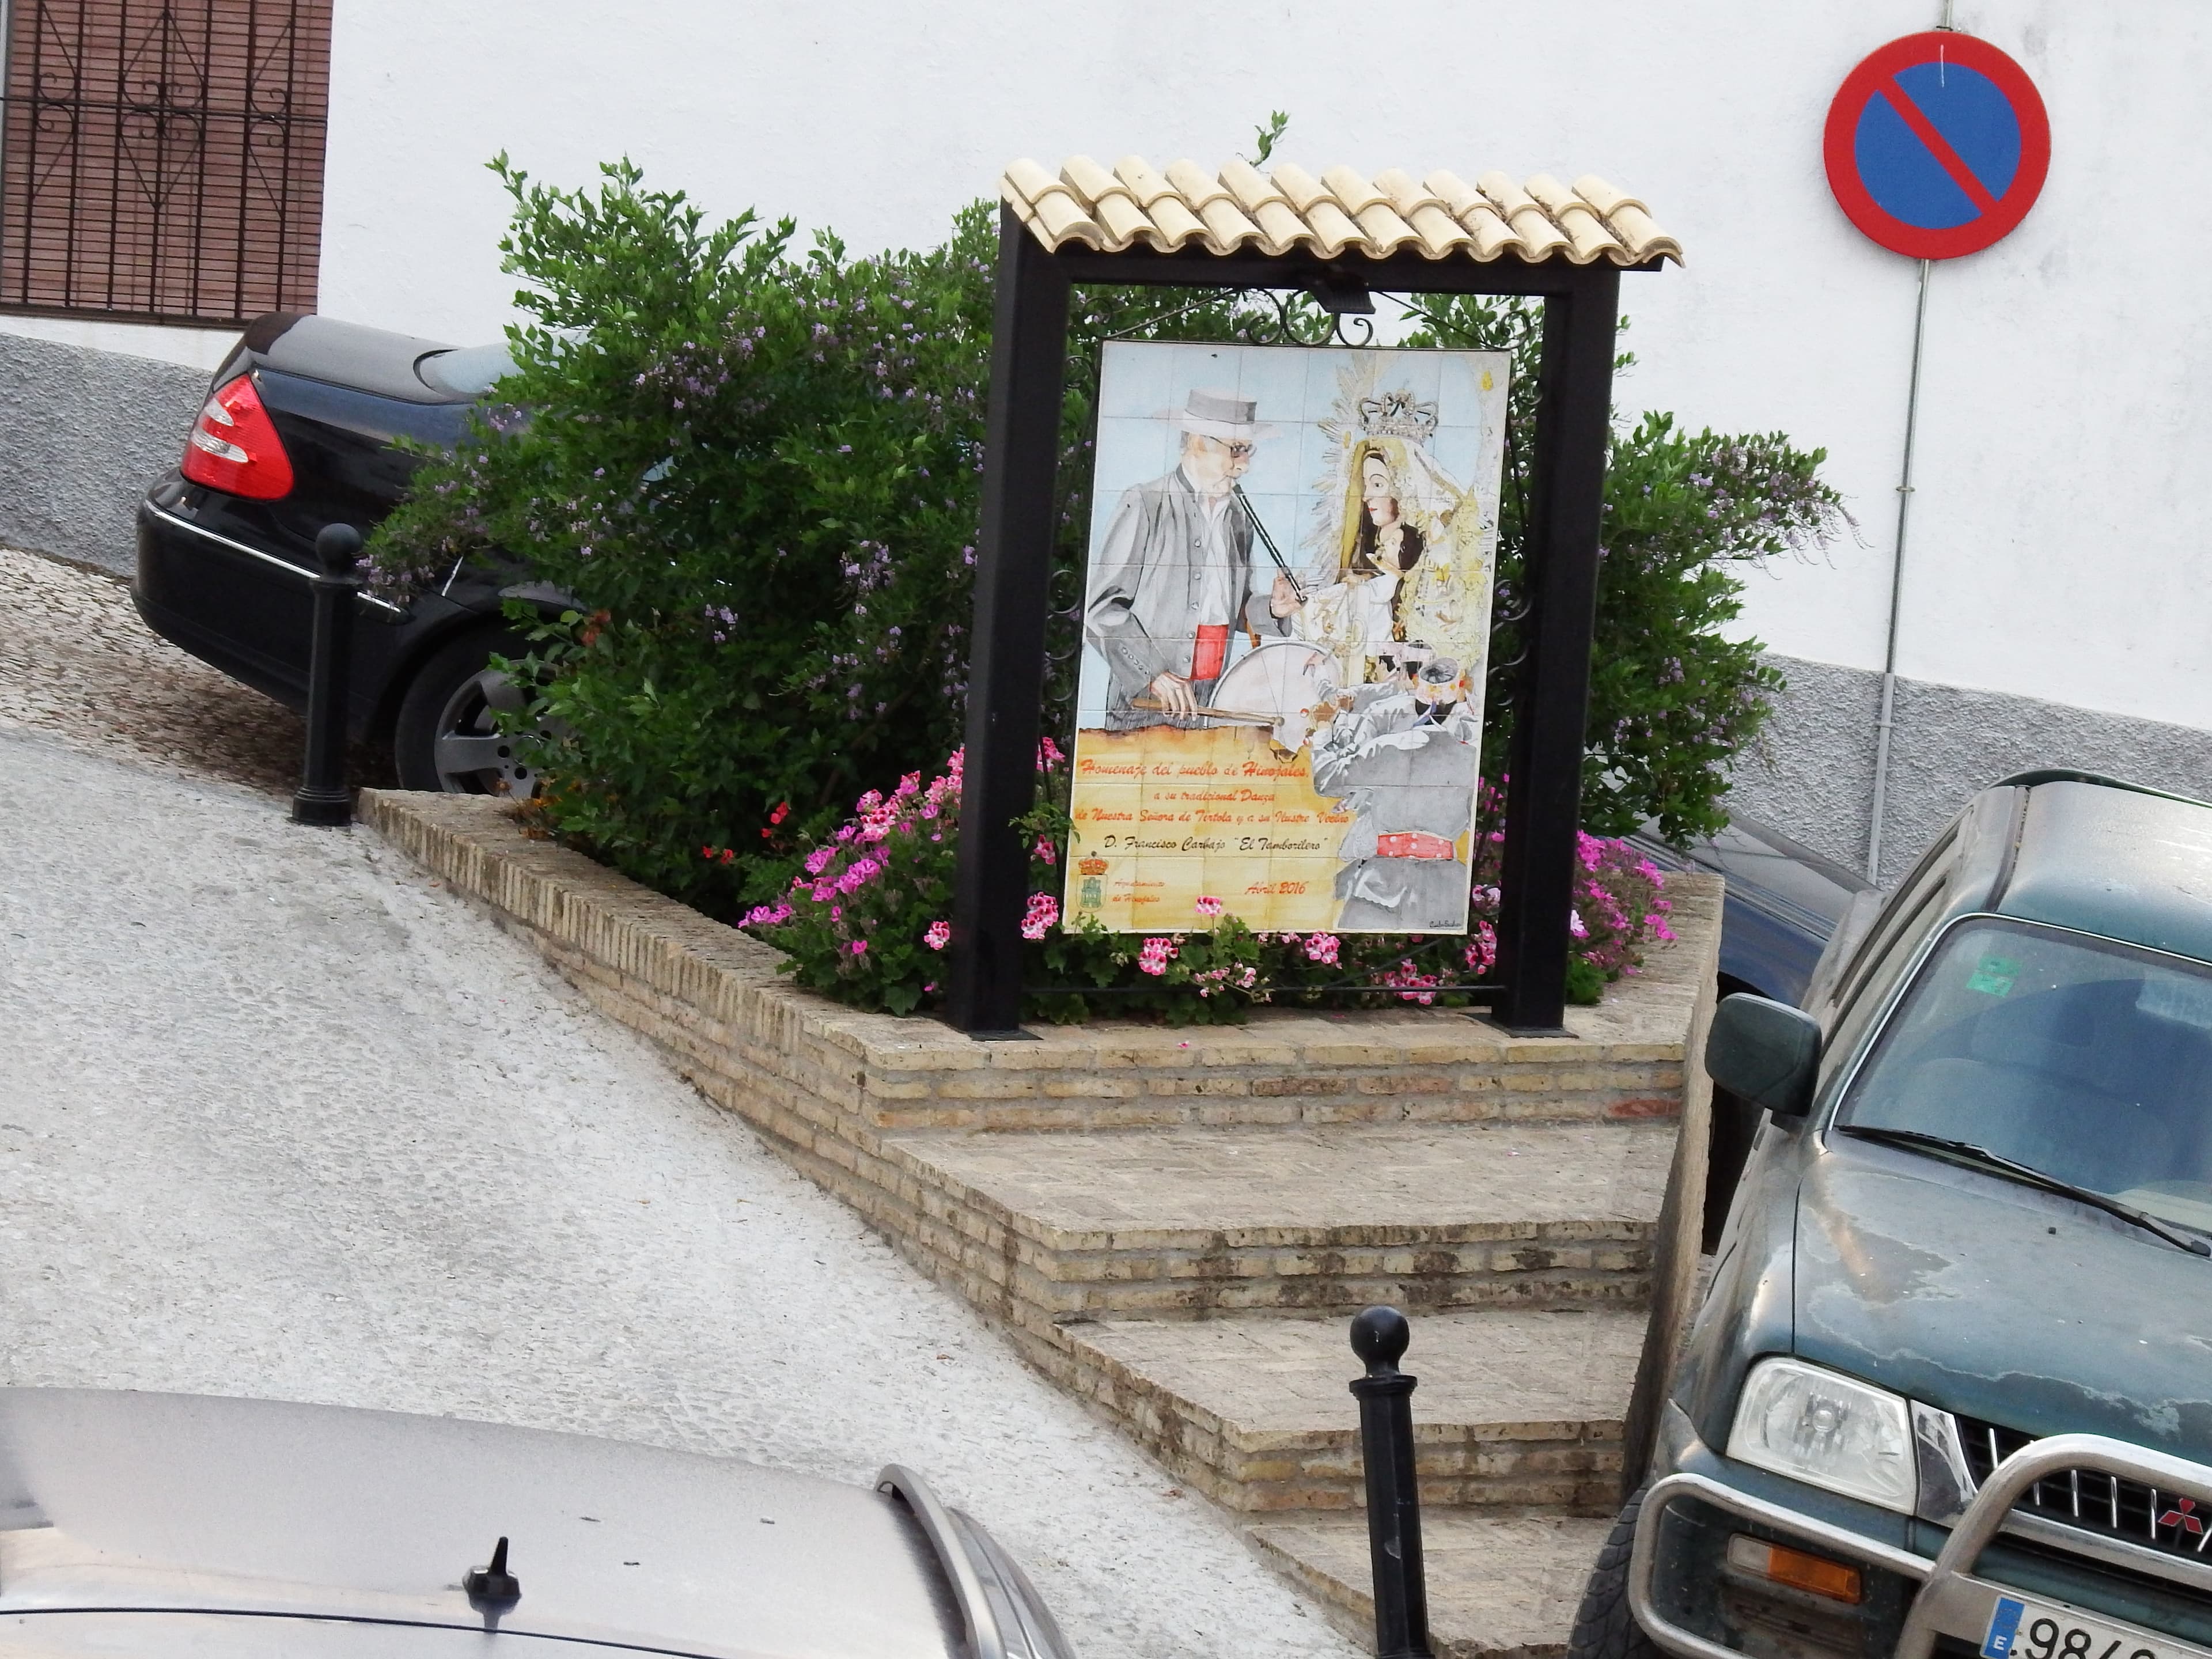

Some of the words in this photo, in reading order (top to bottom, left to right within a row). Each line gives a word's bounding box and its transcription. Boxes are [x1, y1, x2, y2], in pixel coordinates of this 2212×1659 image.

[1080, 759, 1147, 779] Homenaje
[1152, 762, 1173, 775] del
[1177, 760, 1218, 778] pueblo
[1224, 763, 1237, 775] de
[1153, 791, 1160, 800] a
[1180, 789, 1238, 801] tradicional
[1241, 789, 1275, 804] Danza
[1075, 809, 1088, 820] de
[1092, 807, 1133, 821] Nuestra
[1139, 809, 1173, 821] Señora
[1179, 811, 1191, 821] de
[1236, 816, 1244, 825] y
[1258, 814, 1270, 822] su
[1104, 835, 1116, 849] D.
[1124, 836, 1177, 850] Francisco
[1181, 836, 1225, 853] Carbajo
[1244, 881, 1277, 895] Abril
[1279, 881, 1309, 895] 2016
[1112, 894, 1121, 902] de
[1993, 1635, 2008, 1652] E
[2025, 1618, 2157, 1659] 98
